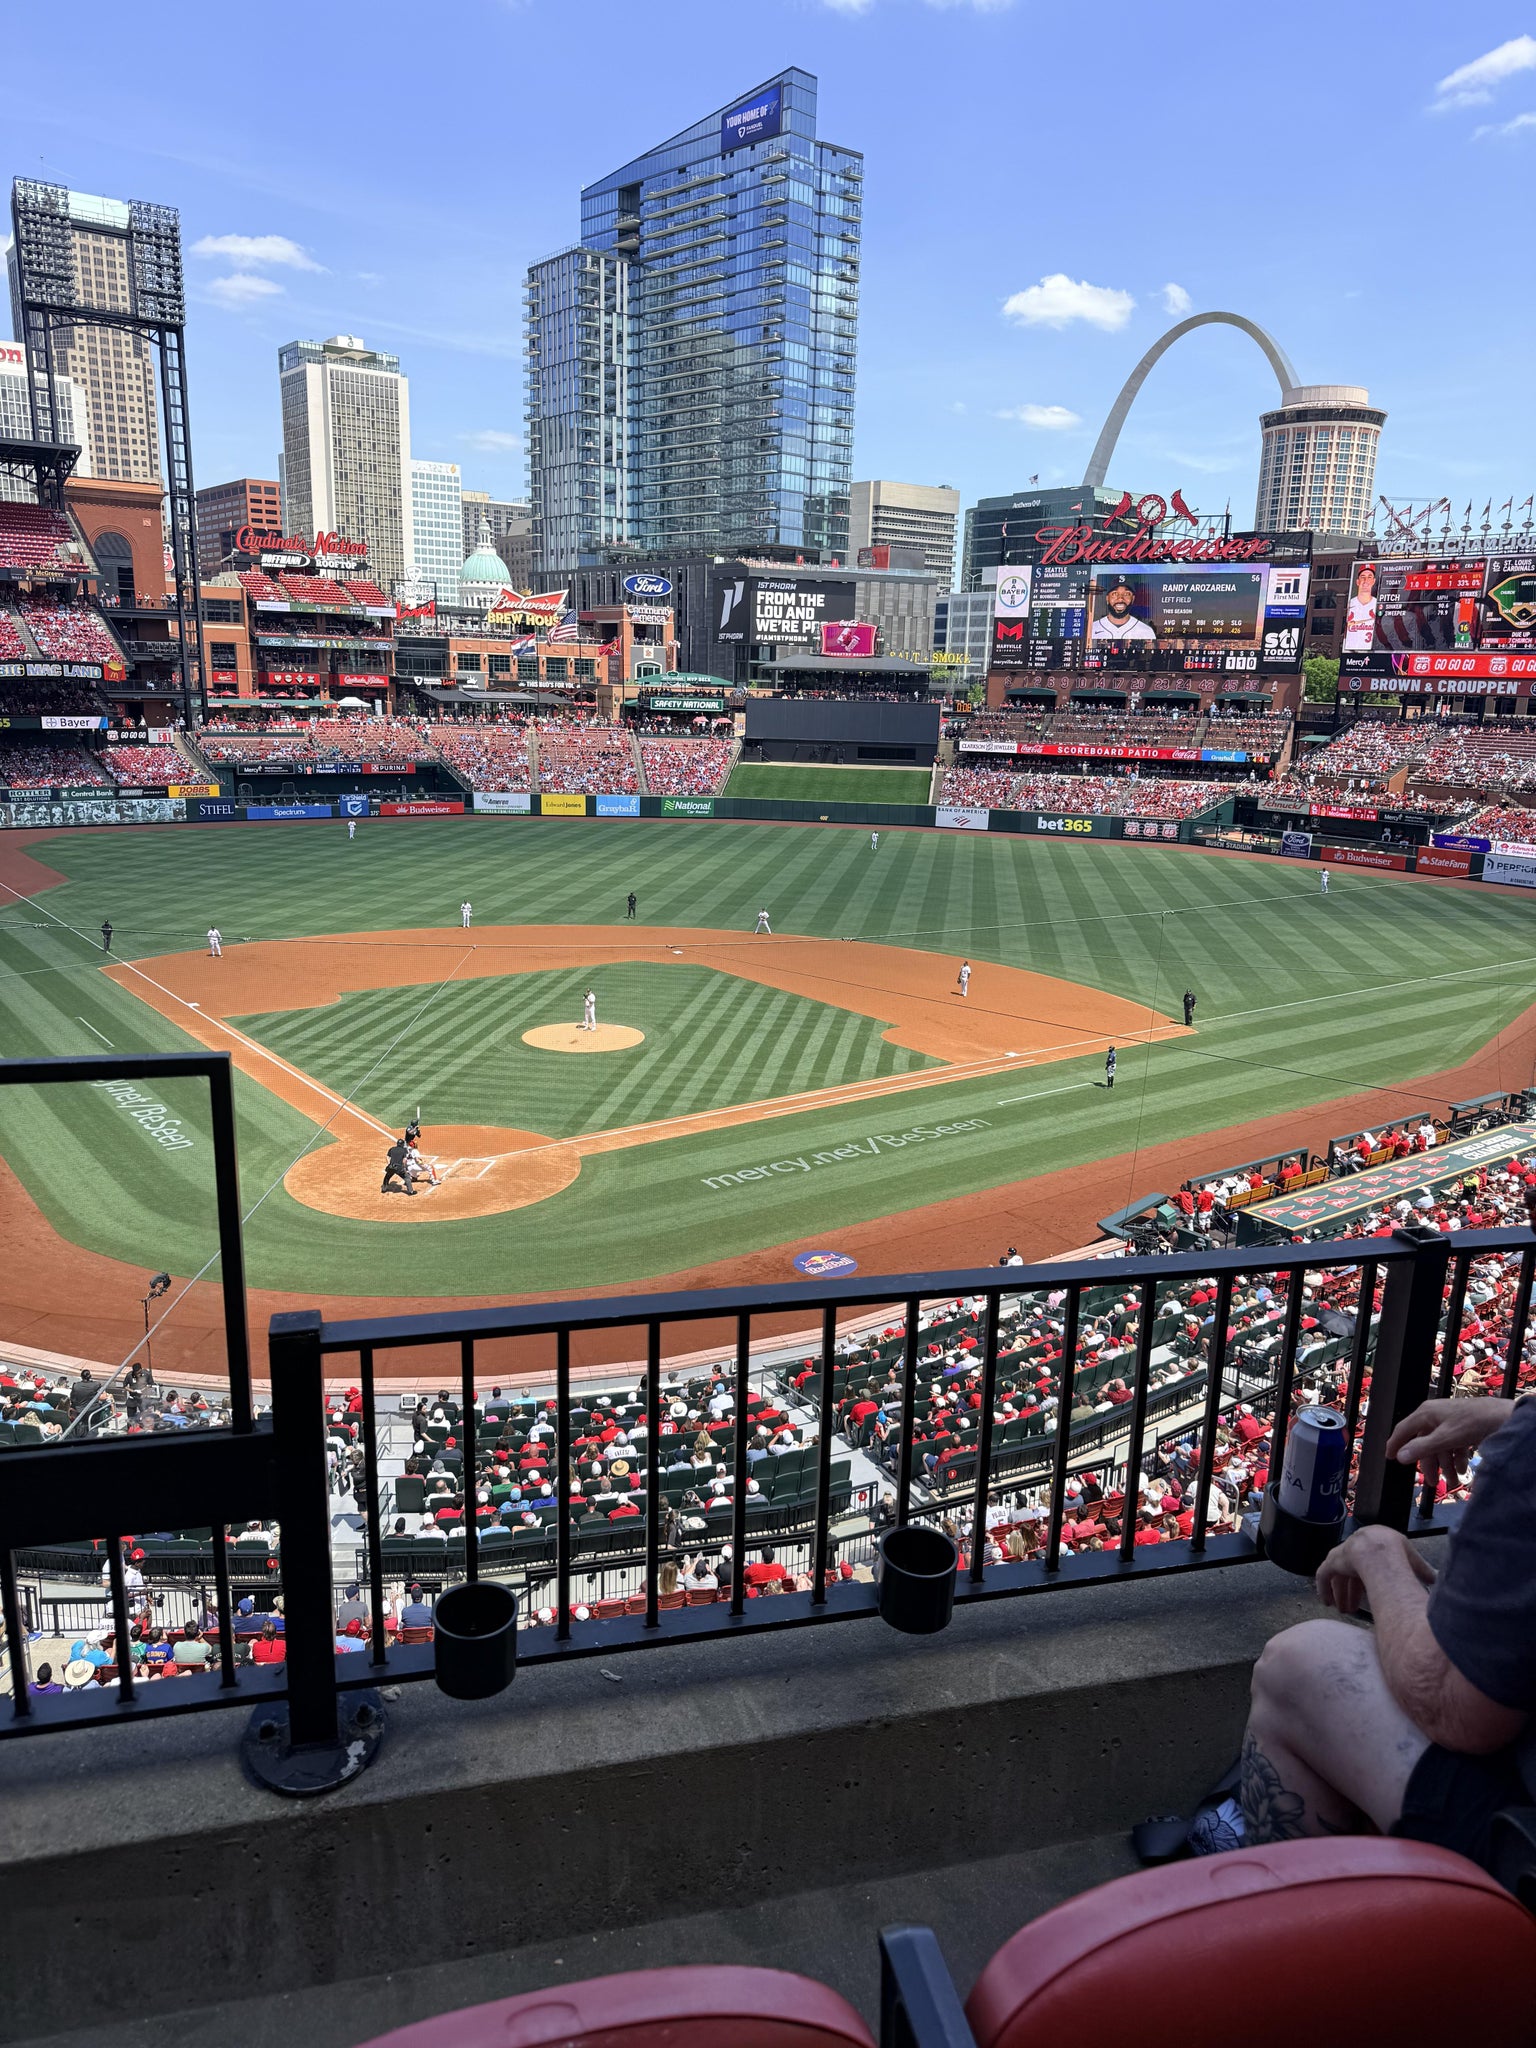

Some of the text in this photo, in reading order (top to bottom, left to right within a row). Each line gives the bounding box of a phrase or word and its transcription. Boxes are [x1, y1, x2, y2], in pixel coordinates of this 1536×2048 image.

[726, 104, 768, 128] YOUR HOME OF
[308, 531, 368, 557] Nation
[1035, 526, 1271, 565] Budweiser
[1377, 540, 1439, 555] WORLD
[316, 560, 357, 569] ROOFTOP
[634, 576, 664, 592] Ford
[1162, 584, 1236, 592] RANDY AROZARENA
[492, 596, 566, 612] Budweiser
[757, 592, 825, 607] FROM THE
[396, 600, 436, 620] Live!
[628, 605, 672, 617] Community
[756, 606, 815, 620] LOU AND
[488, 613, 522, 625] BREW
[756, 619, 799, 632] WE'RE
[1265, 628, 1299, 648] stl
[1346, 658, 1365, 667] Mercy
[1434, 659, 1446, 669] GO
[1448, 659, 1460, 670] GO
[1462, 659, 1475, 671] GO
[1512, 660, 1524, 671] GO
[26, 664, 62, 677] MAC
[63, 664, 102, 679] LAND
[1061, 676, 1069, 688] 9
[1113, 678, 1124, 689] 17
[1131, 679, 1145, 689] 20
[1154, 678, 1169, 690] 23
[1176, 679, 1191, 690] 24
[1199, 679, 1214, 691] 42
[1222, 680, 1238, 691] 45
[1370, 678, 1518, 694] BROWN & CROUPPEN
[683, 701, 719, 709] NATIONAL
[60, 718, 90, 728] Bayer
[1021, 745, 1043, 754] Coca-Cola
[1058, 746, 1124, 757] SCOREBOARD
[1128, 749, 1158, 757] PATIO
[1172, 750, 1197, 760] Coca-Cola
[200, 804, 234, 815] STIFEL
[410, 805, 450, 815] Budweiser
[675, 801, 711, 810] National
[1262, 800, 1304, 810] Schnucks
[274, 808, 304, 816] Spectrum
[1037, 817, 1092, 832] bet365
[1288, 833, 1307, 843] Ford
[1226, 842, 1252, 851] STADIUM
[1347, 853, 1392, 866] Budweiser
[1430, 857, 1468, 869] State Farm
[700, 1118, 992, 1189] mercy.net/BeSeen
[804, 1257, 854, 1276] Red Bull
